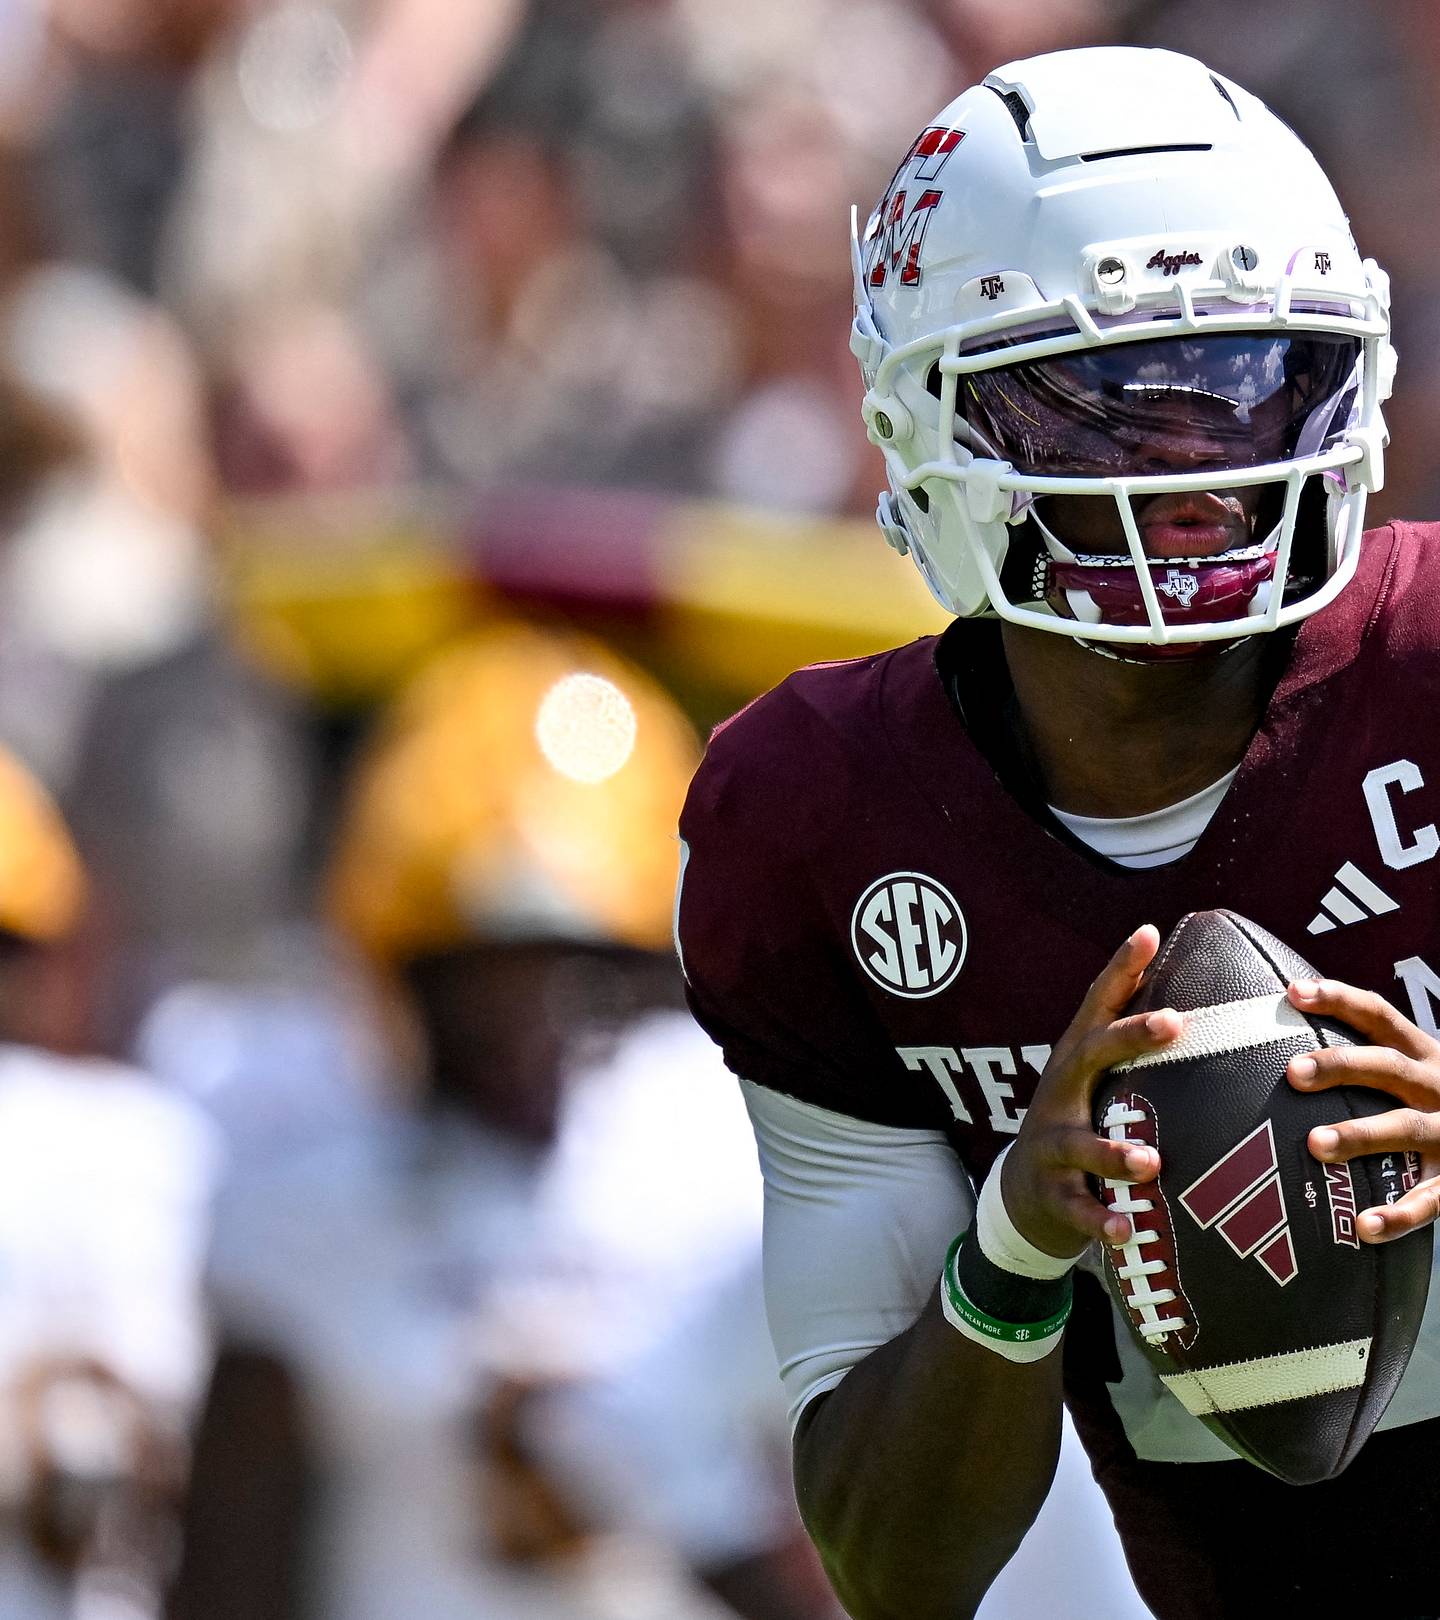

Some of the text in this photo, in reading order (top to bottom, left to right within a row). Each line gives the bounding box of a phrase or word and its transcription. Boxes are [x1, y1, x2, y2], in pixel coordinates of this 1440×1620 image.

[1146, 249, 1203, 276] Aggies
[860, 882, 957, 989] SEC
[1304, 1181, 1317, 1208] USA
[964, 1311, 982, 1328] MEAN
[982, 1322, 1001, 1336] MORE
[1015, 1328, 1031, 1341] SEC
